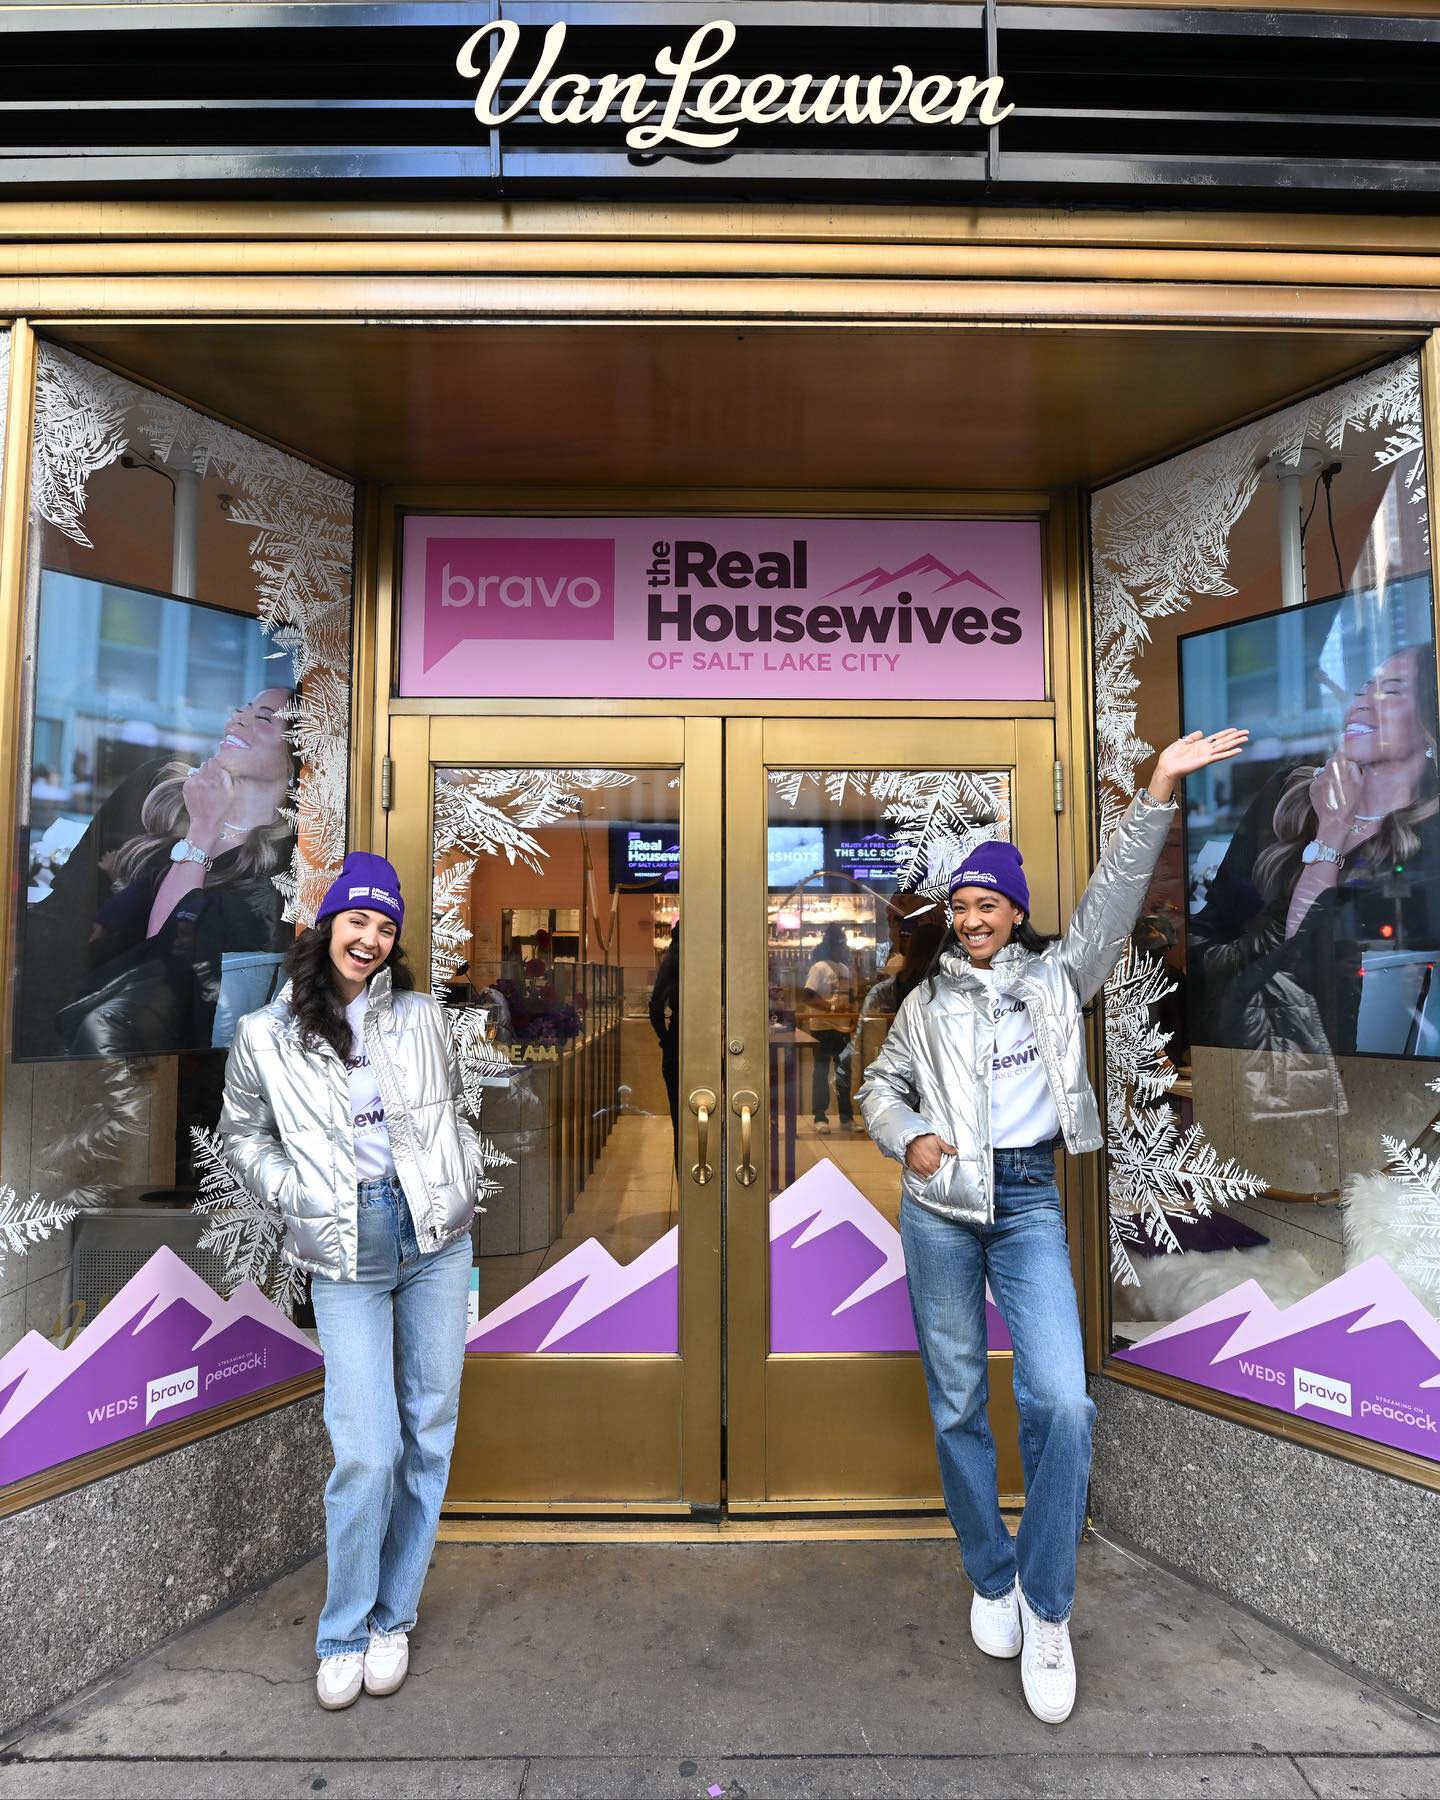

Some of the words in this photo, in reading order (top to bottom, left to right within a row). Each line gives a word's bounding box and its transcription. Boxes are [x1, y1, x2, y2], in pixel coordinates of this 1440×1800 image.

[647, 540, 671, 588] the
[674, 539, 808, 589] Real
[441, 562, 601, 608] bravo
[647, 591, 1023, 645] Housewives
[647, 651, 684, 671] OF
[692, 651, 755, 671] SALT
[763, 652, 833, 672] LAKE
[841, 653, 901, 672] CITY
[637, 839, 662, 851] Real
[834, 848, 855, 858] THE
[857, 848, 877, 858] SLC
[205, 1353, 263, 1391] peacock
[1238, 1359, 1287, 1386] WEDS
[150, 1378, 195, 1404] bravo
[1298, 1377, 1348, 1405] bravo
[1375, 1395, 1413, 1411] STREAMING
[1413, 1406, 1425, 1414] ON
[87, 1395, 139, 1425] WEDS
[1360, 1400, 1438, 1433] peacock
